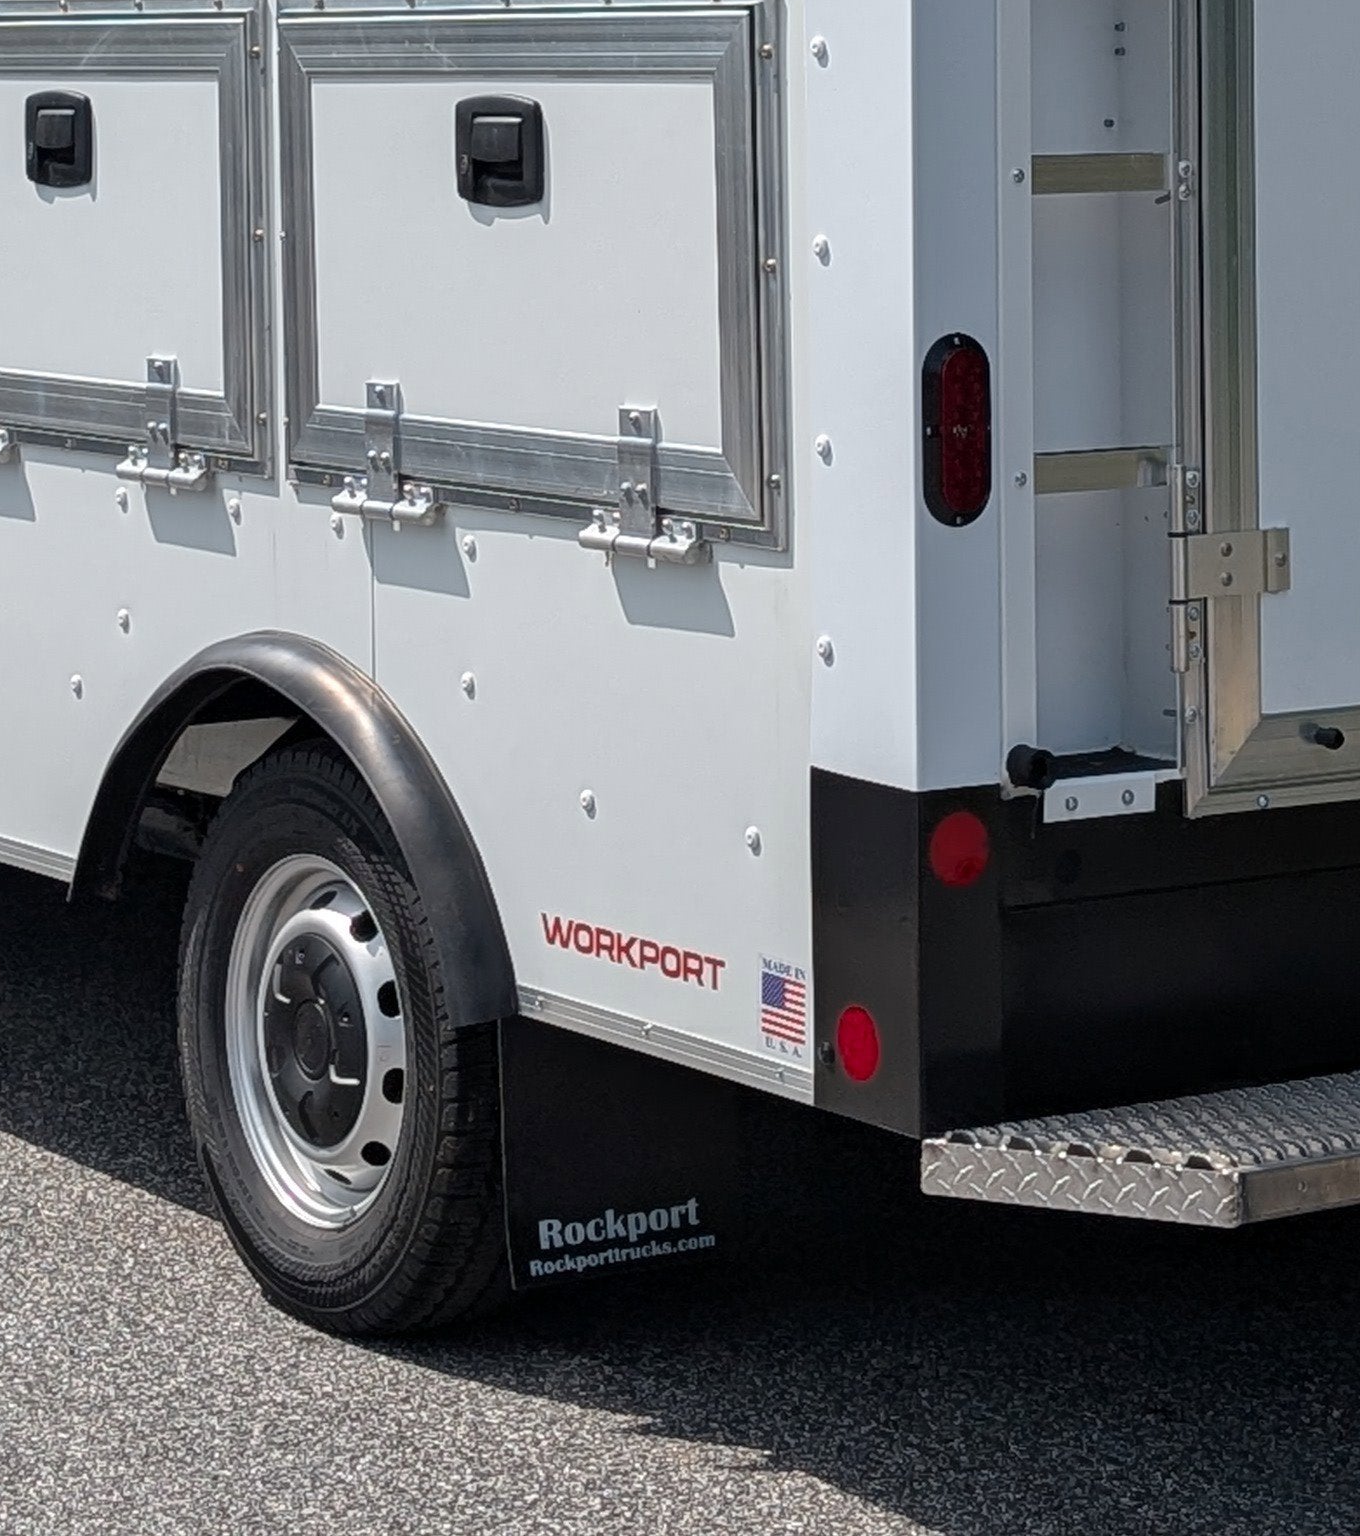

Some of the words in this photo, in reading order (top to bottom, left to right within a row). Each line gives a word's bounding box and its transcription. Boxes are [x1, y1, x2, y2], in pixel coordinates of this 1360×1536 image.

[540, 912, 726, 991] WORKPORT
[762, 957, 792, 977] MADE
[794, 966, 806, 980] IN
[538, 1197, 701, 1250] Rockport
[529, 1233, 716, 1277] Rockporttrucks.com
